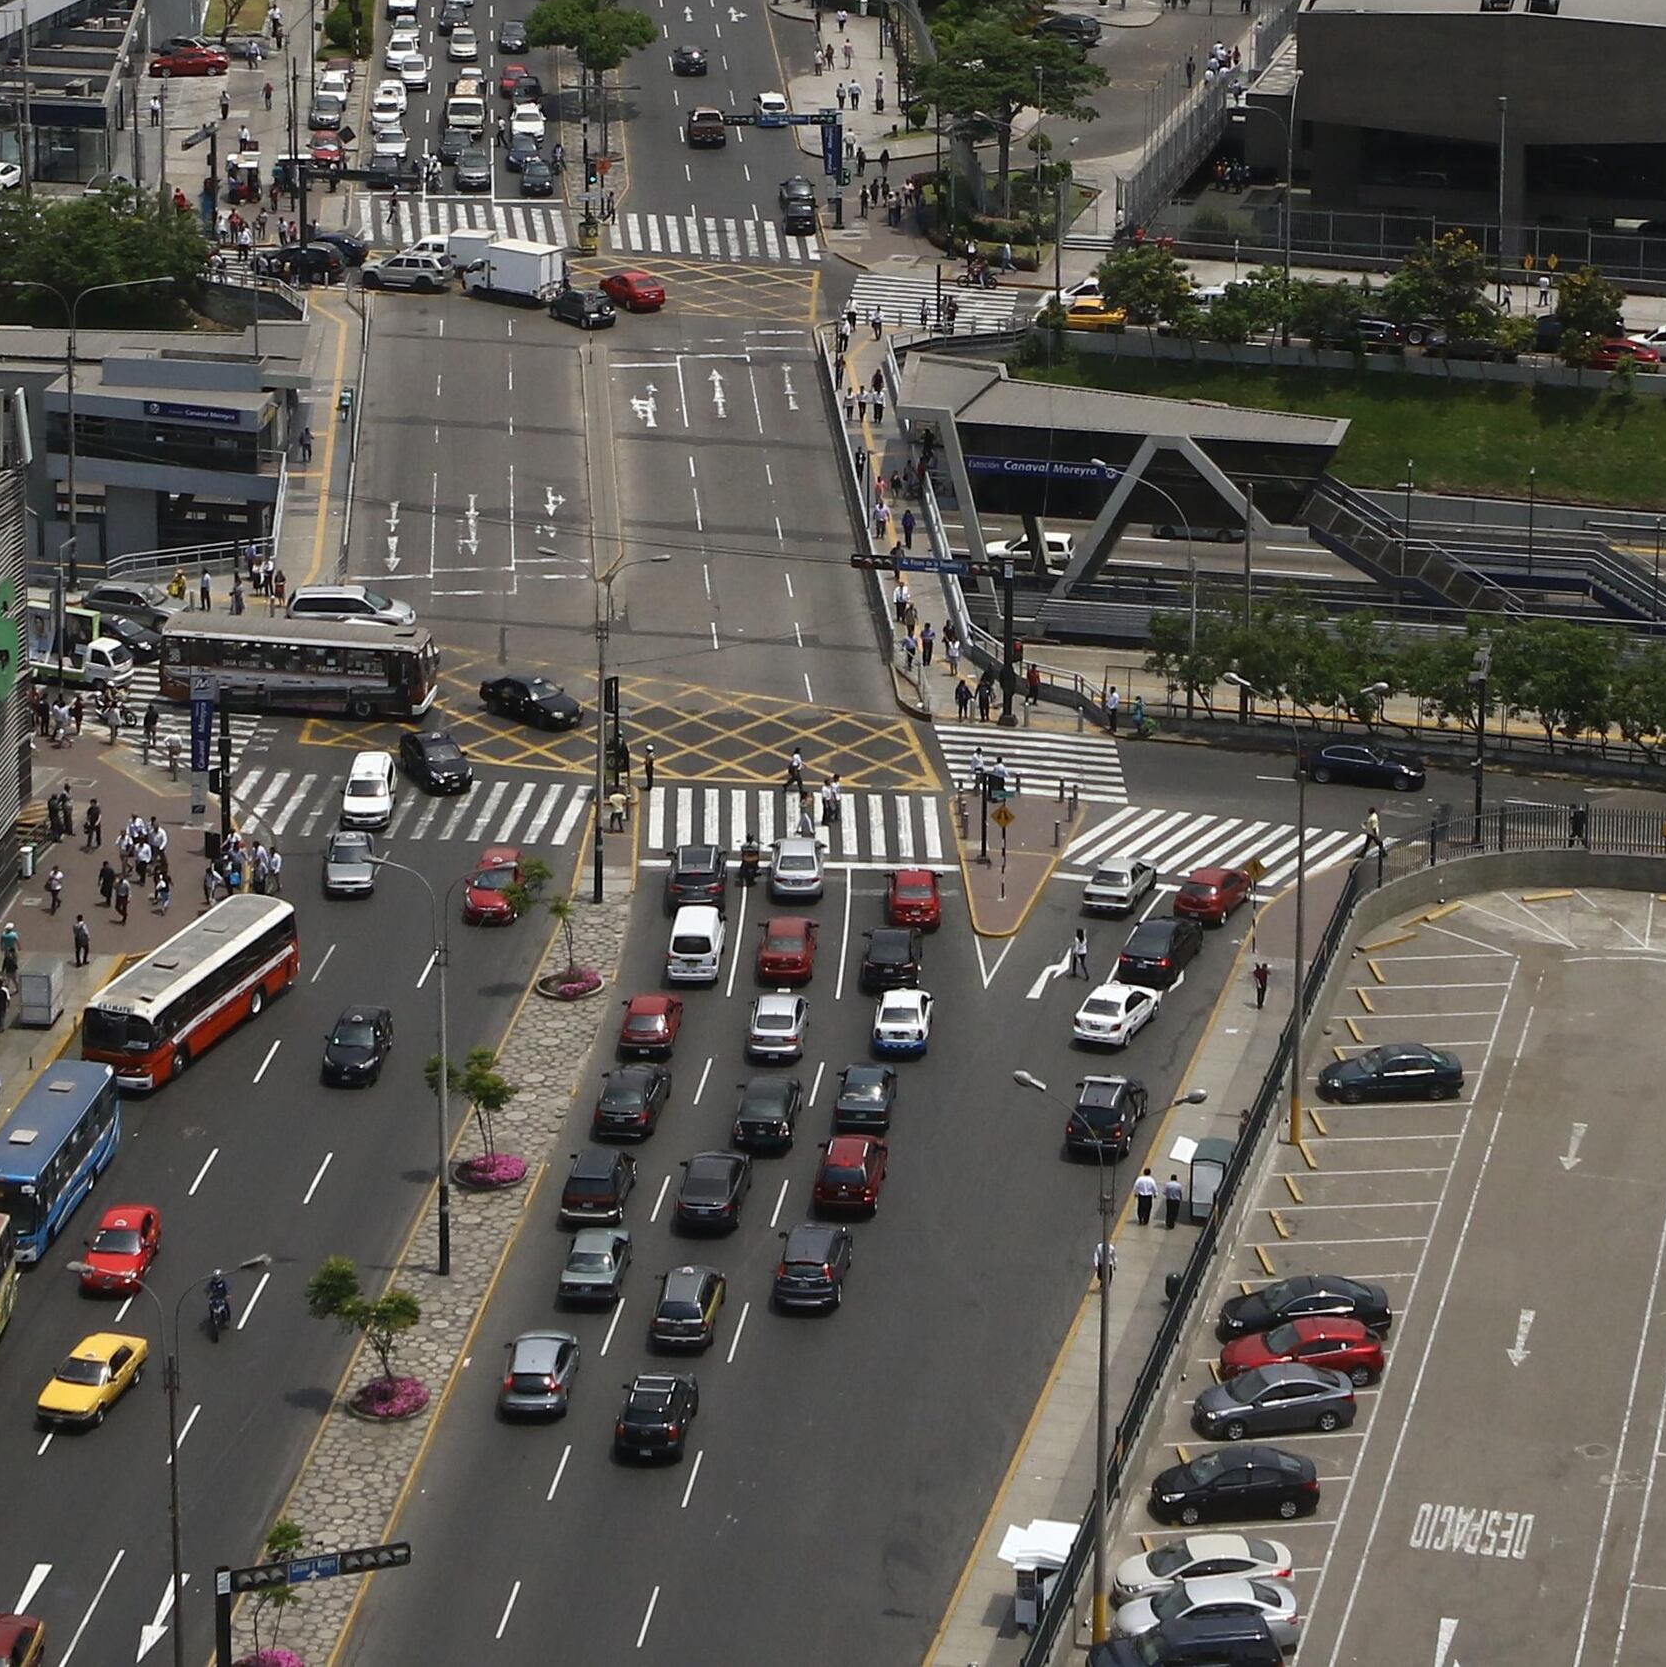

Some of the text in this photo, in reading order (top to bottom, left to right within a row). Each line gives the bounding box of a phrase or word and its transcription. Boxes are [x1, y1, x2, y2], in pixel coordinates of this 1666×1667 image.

[1004, 460, 1050, 473] Canaval
[1053, 464, 1097, 477] Moreyra
[1409, 1502, 1536, 1560] DESPACIO
